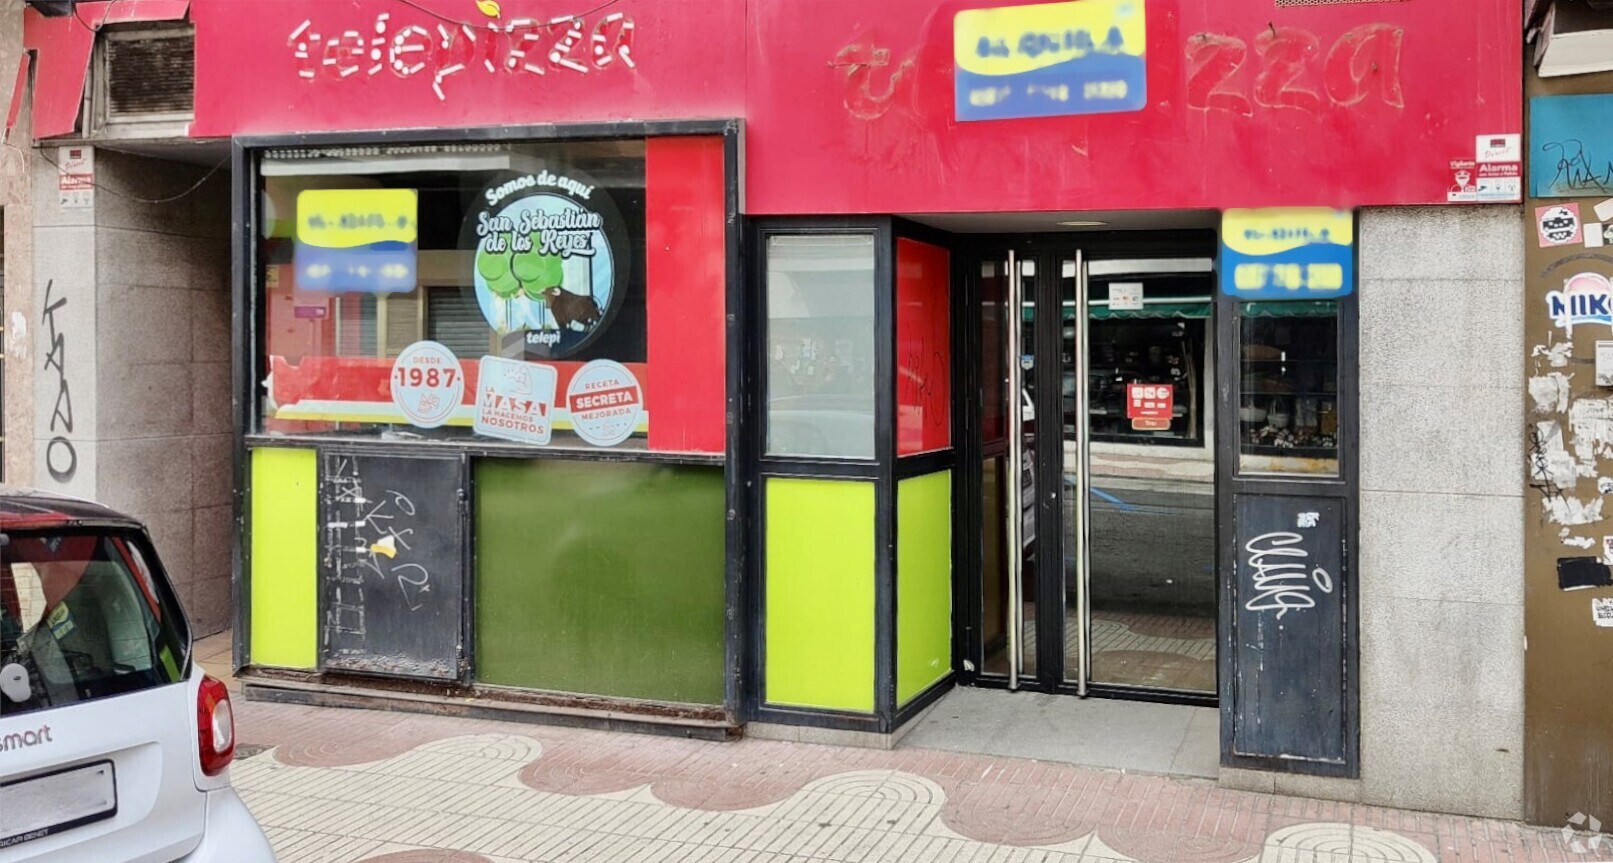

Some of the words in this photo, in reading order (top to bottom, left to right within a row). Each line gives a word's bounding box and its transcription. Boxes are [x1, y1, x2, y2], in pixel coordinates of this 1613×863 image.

[288, 12, 636, 101] telepizza
[1479, 163, 1518, 173] Alarma
[485, 174, 536, 206] Somos
[536, 169, 557, 186] de
[557, 175, 596, 200] aquí
[477, 211, 513, 237] San
[519, 207, 601, 235] Sebastián
[485, 232, 507, 253] de
[511, 230, 533, 252] los
[538, 228, 597, 258] Reyes
[412, 356, 441, 365] DESDE
[397, 366, 456, 388] 1987
[584, 379, 619, 390] RECETA
[483, 393, 547, 417] MASA
[575, 391, 633, 409] SECRETA
[494, 411, 533, 422] HACEMOS
[581, 408, 631, 420] MEJORADA
[481, 416, 545, 434] NOSOTROS
